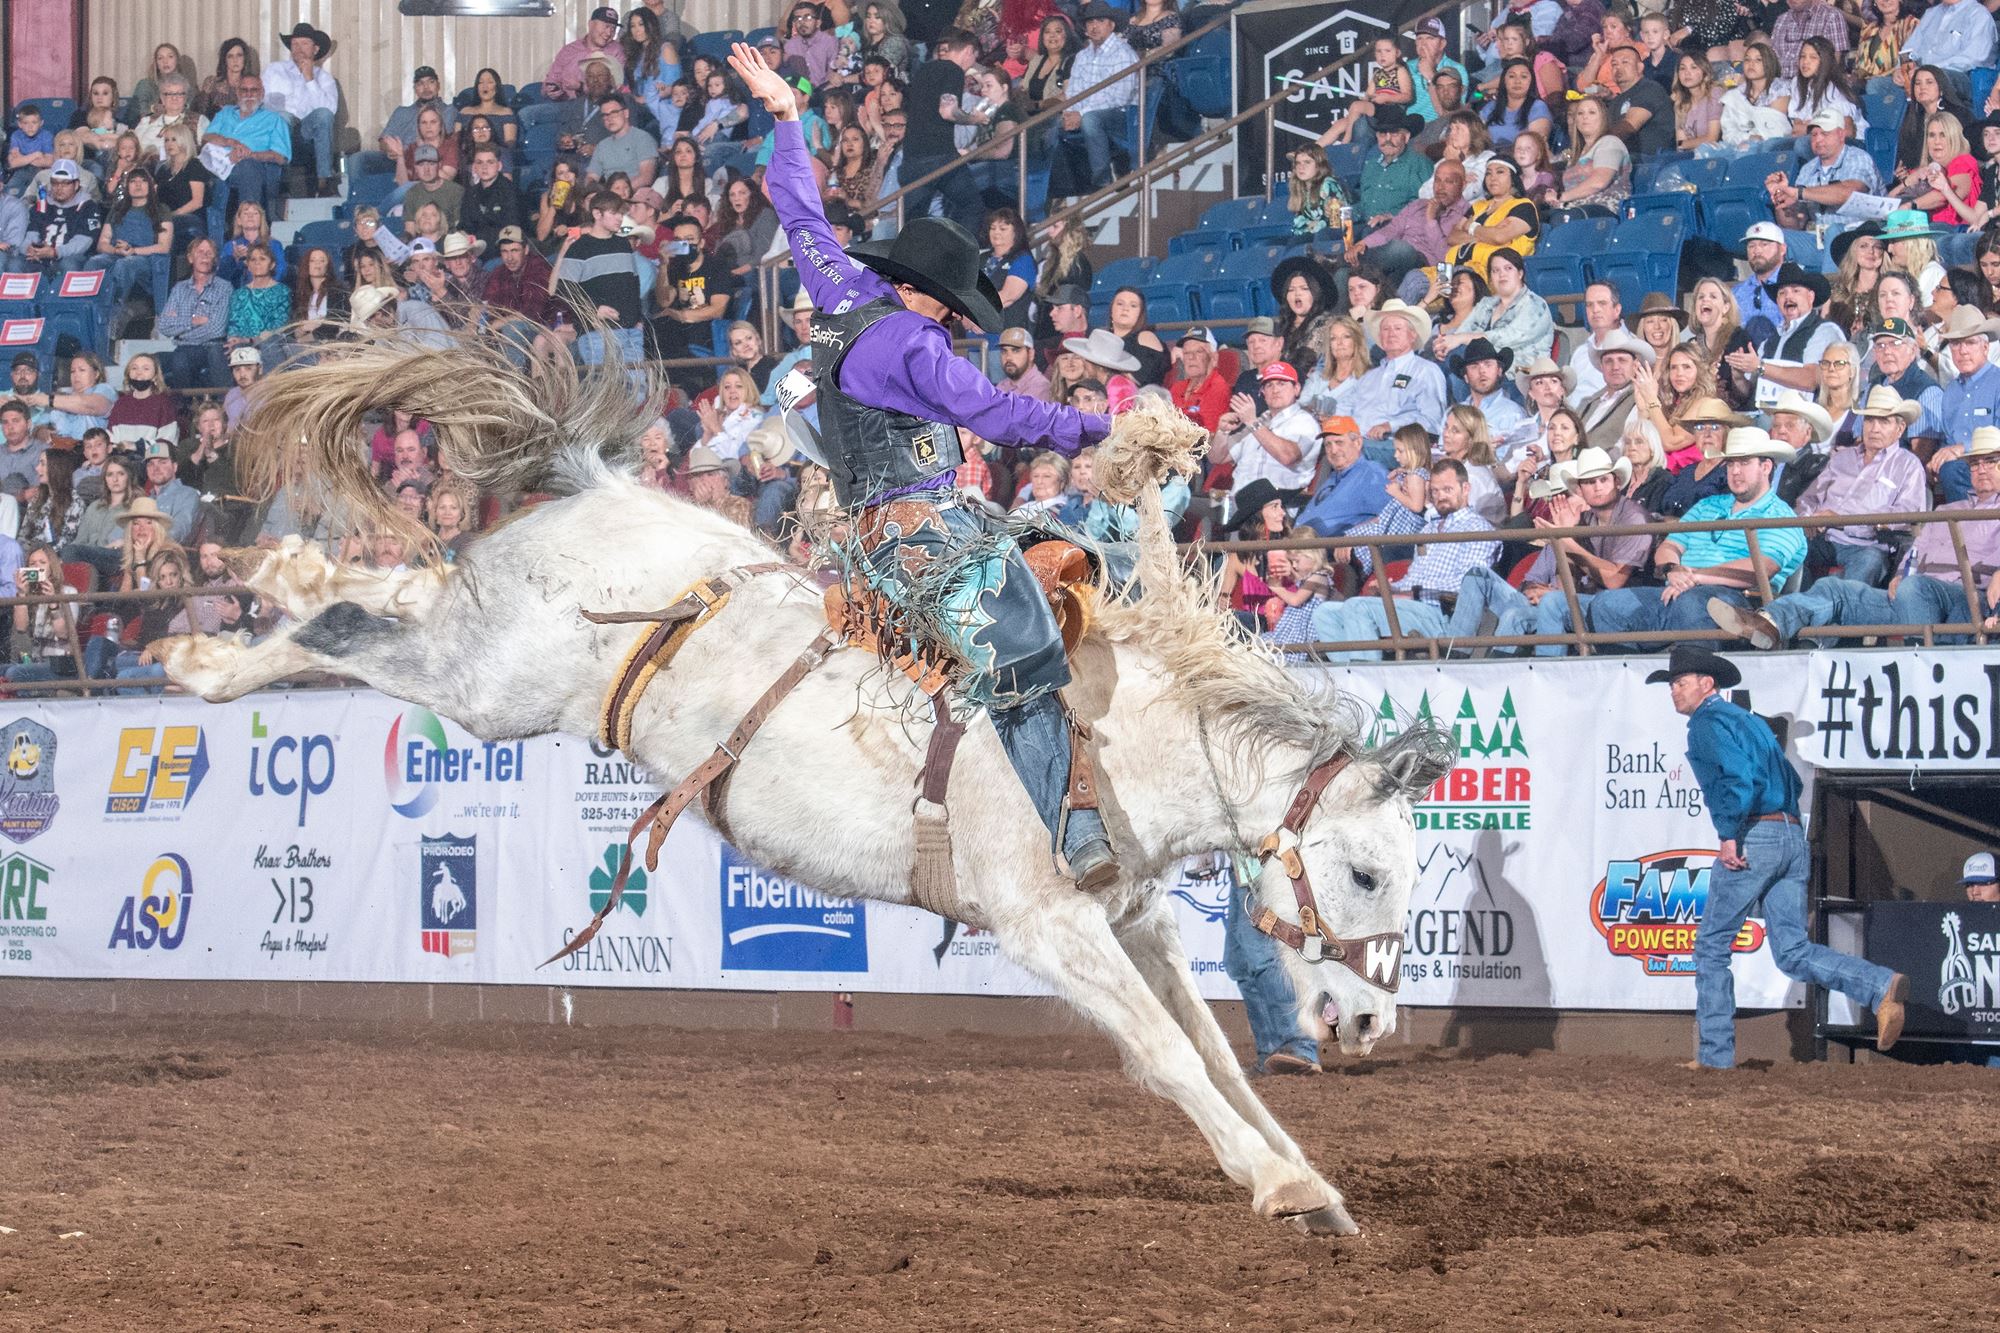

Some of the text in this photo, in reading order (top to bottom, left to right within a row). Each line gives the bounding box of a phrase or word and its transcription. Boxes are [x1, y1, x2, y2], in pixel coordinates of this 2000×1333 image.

[1304, 45, 1330, 56] SINCE
[1282, 62, 1381, 103] GAN
[803, 246, 844, 286] BAILEY
[1817, 660, 2000, 760] #this
[108, 725, 199, 801] CE
[160, 761, 191, 770] Equipment
[249, 711, 335, 827] icp
[406, 740, 524, 783] Ener-Tel
[1606, 741, 1683, 781] Bank of
[575, 791, 601, 801] DOVE
[601, 791, 629, 802] HUNTS
[638, 791, 663, 801] VEN
[1424, 767, 1531, 802] BER
[1605, 778, 1703, 817] San Ang
[111, 798, 141, 812] CISCO
[149, 801, 181, 810] Since 1978
[494, 806, 506, 818] on
[581, 807, 646, 820] 325-374-31
[1411, 812, 1532, 831] OLESALE
[283, 844, 332, 869] Brothers
[0, 857, 49, 920] RC
[727, 866, 855, 909] FiberM
[1600, 861, 1712, 920] FAM
[11, 926, 44, 937] ROOFING
[45, 926, 57, 937] CO
[107, 895, 192, 950] ASU
[823, 911, 854, 925] cotton
[1402, 909, 1514, 956] EGEND
[1, 950, 33, 960] 1928
[563, 927, 673, 973] SHANNON
[951, 942, 999, 956] DELIVERY
[1366, 936, 1400, 985] W
[1401, 959, 1522, 982] ngs & Insulation
[1974, 1012, 2000, 1022] STOC
